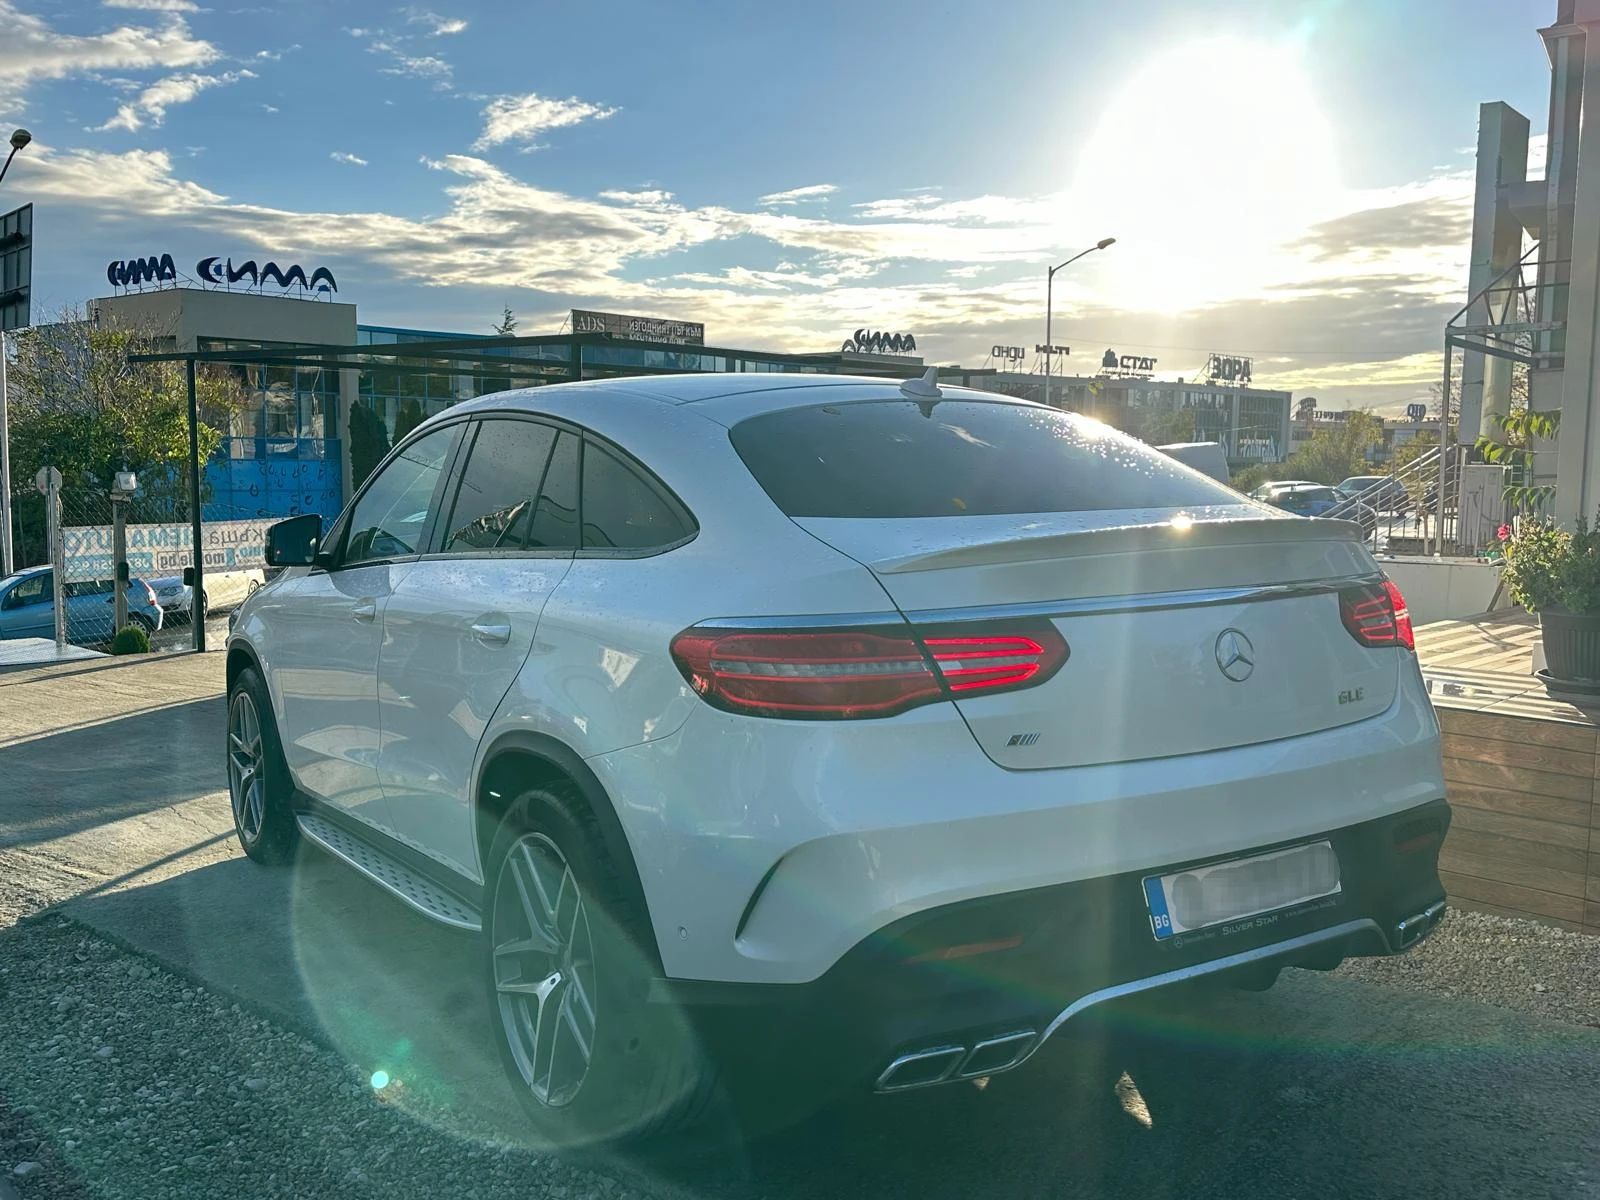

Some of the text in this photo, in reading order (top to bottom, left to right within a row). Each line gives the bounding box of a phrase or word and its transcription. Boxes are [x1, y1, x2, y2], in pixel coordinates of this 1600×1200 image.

[577, 316, 605, 332] ADS
[629, 321, 670, 335] ИЗГОДНИЯТ
[685, 326, 702, 338] КЪМ
[1211, 356, 1252, 382] ЗОРА
[1338, 687, 1365, 705] GLE
[1154, 913, 1170, 930] BG
